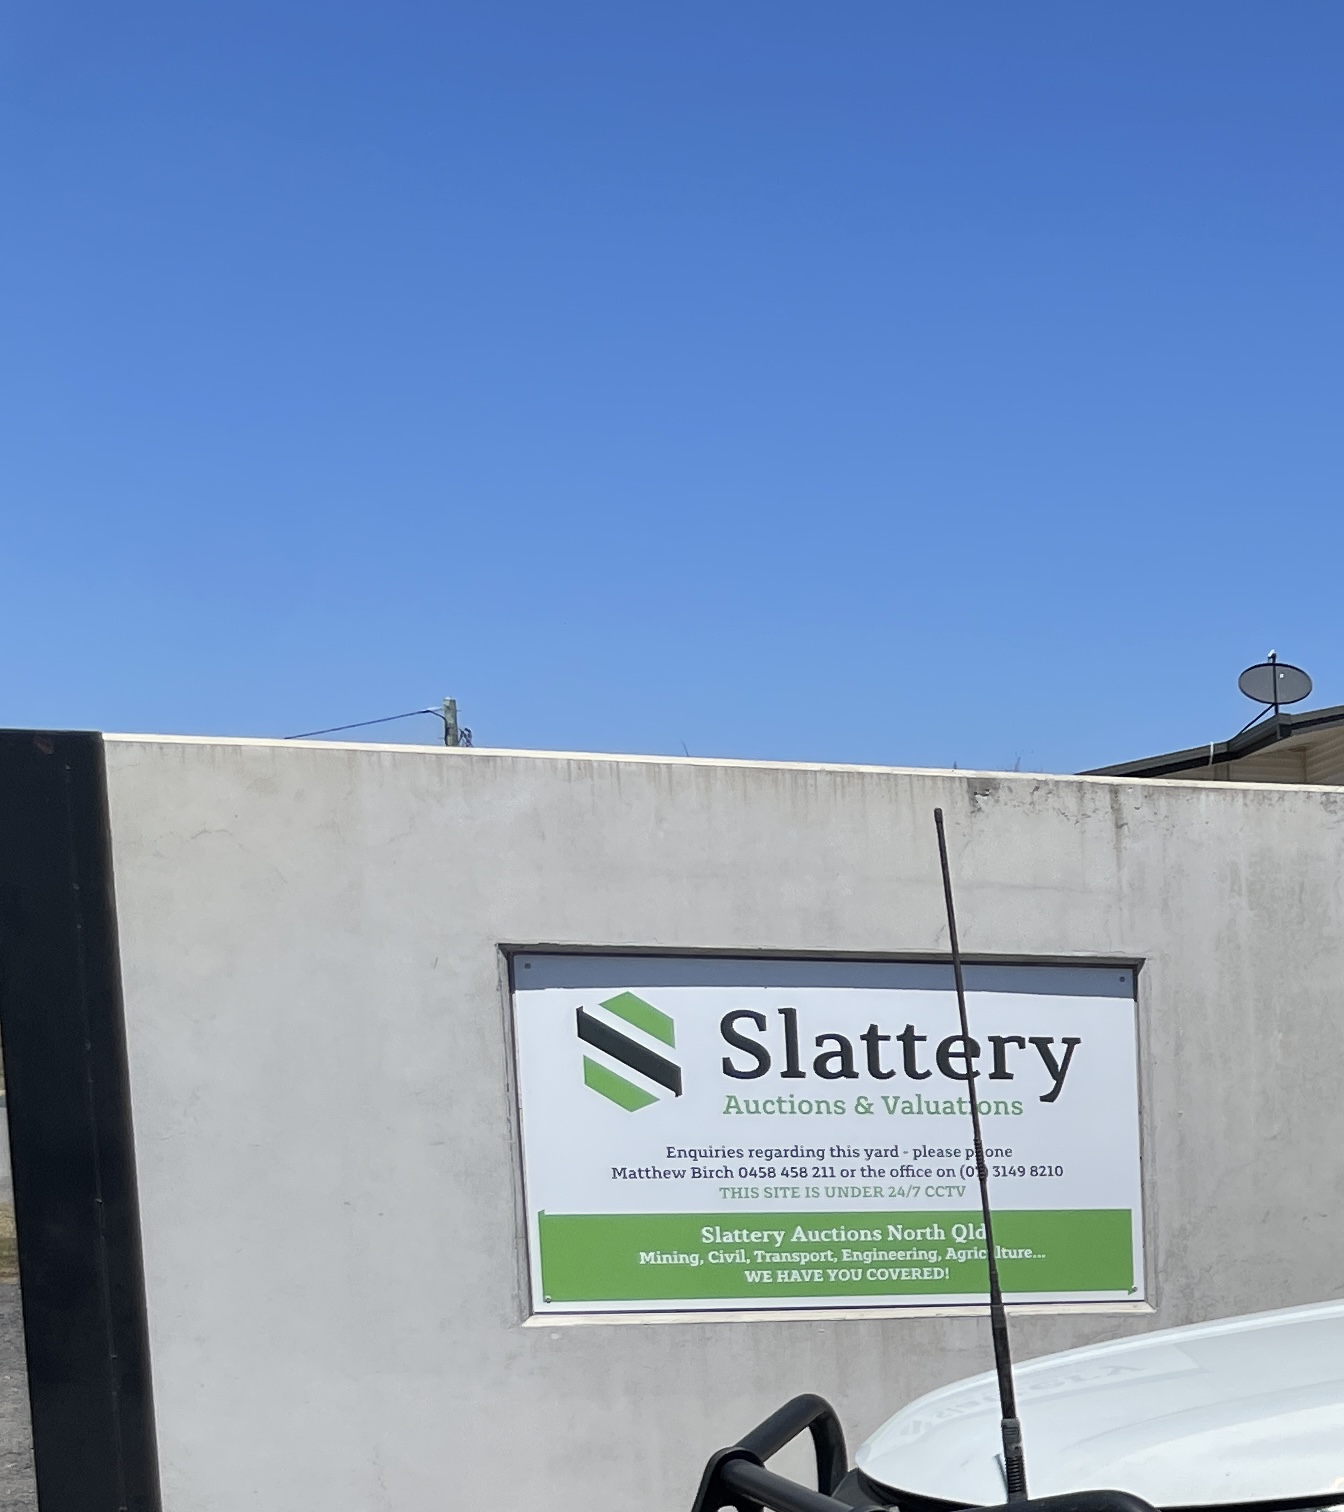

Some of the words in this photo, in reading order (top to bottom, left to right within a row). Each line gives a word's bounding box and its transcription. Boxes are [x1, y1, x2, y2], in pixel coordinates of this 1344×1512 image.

[720, 1007, 1082, 1103] Slattery
[723, 1095, 846, 1115] Auctions
[855, 1095, 874, 1115] &
[881, 1095, 1023, 1116] Valuatons
[666, 1146, 744, 1161] Enquiries
[749, 1145, 825, 1161] regarding
[830, 1145, 860, 1158] this
[863, 1145, 899, 1161] yard
[913, 1145, 961, 1160] please
[965, 1146, 1013, 1160] pone
[611, 1166, 687, 1179] Matthew
[691, 1166, 734, 1179] Birch
[738, 1166, 776, 1178] 0458
[781, 1166, 808, 1178] 458
[812, 1166, 836, 1178] 211
[840, 1168, 856, 1178] or
[860, 1165, 885, 1178] the
[889, 1165, 932, 1178] office
[937, 1167, 957, 1177] on
[992, 1165, 1026, 1177] 3149
[1030, 1165, 1063, 1177] 8210
[719, 1187, 759, 1199] THIS
[764, 1187, 800, 1199] SITE
[805, 1186, 820, 1198] IS
[825, 1186, 884, 1198] UNDER
[888, 1184, 920, 1198] 24/7
[925, 1186, 966, 1197] CCTV
[701, 1226, 785, 1247] Slattery
[791, 1225, 882, 1242] Auctions
[887, 1224, 945, 1241] North
[639, 1250, 704, 1266] Mining,
[708, 1249, 750, 1264] Civil,
[754, 1249, 837, 1265] Transport,
[842, 1248, 942, 1263] Engineering,
[946, 1246, 1046, 1262] Agriclture...
[744, 1271, 772, 1283] WE
[777, 1270, 824, 1283] HAVE
[826, 1269, 862, 1281] YOU
[866, 1268, 949, 1281] COVERED!
